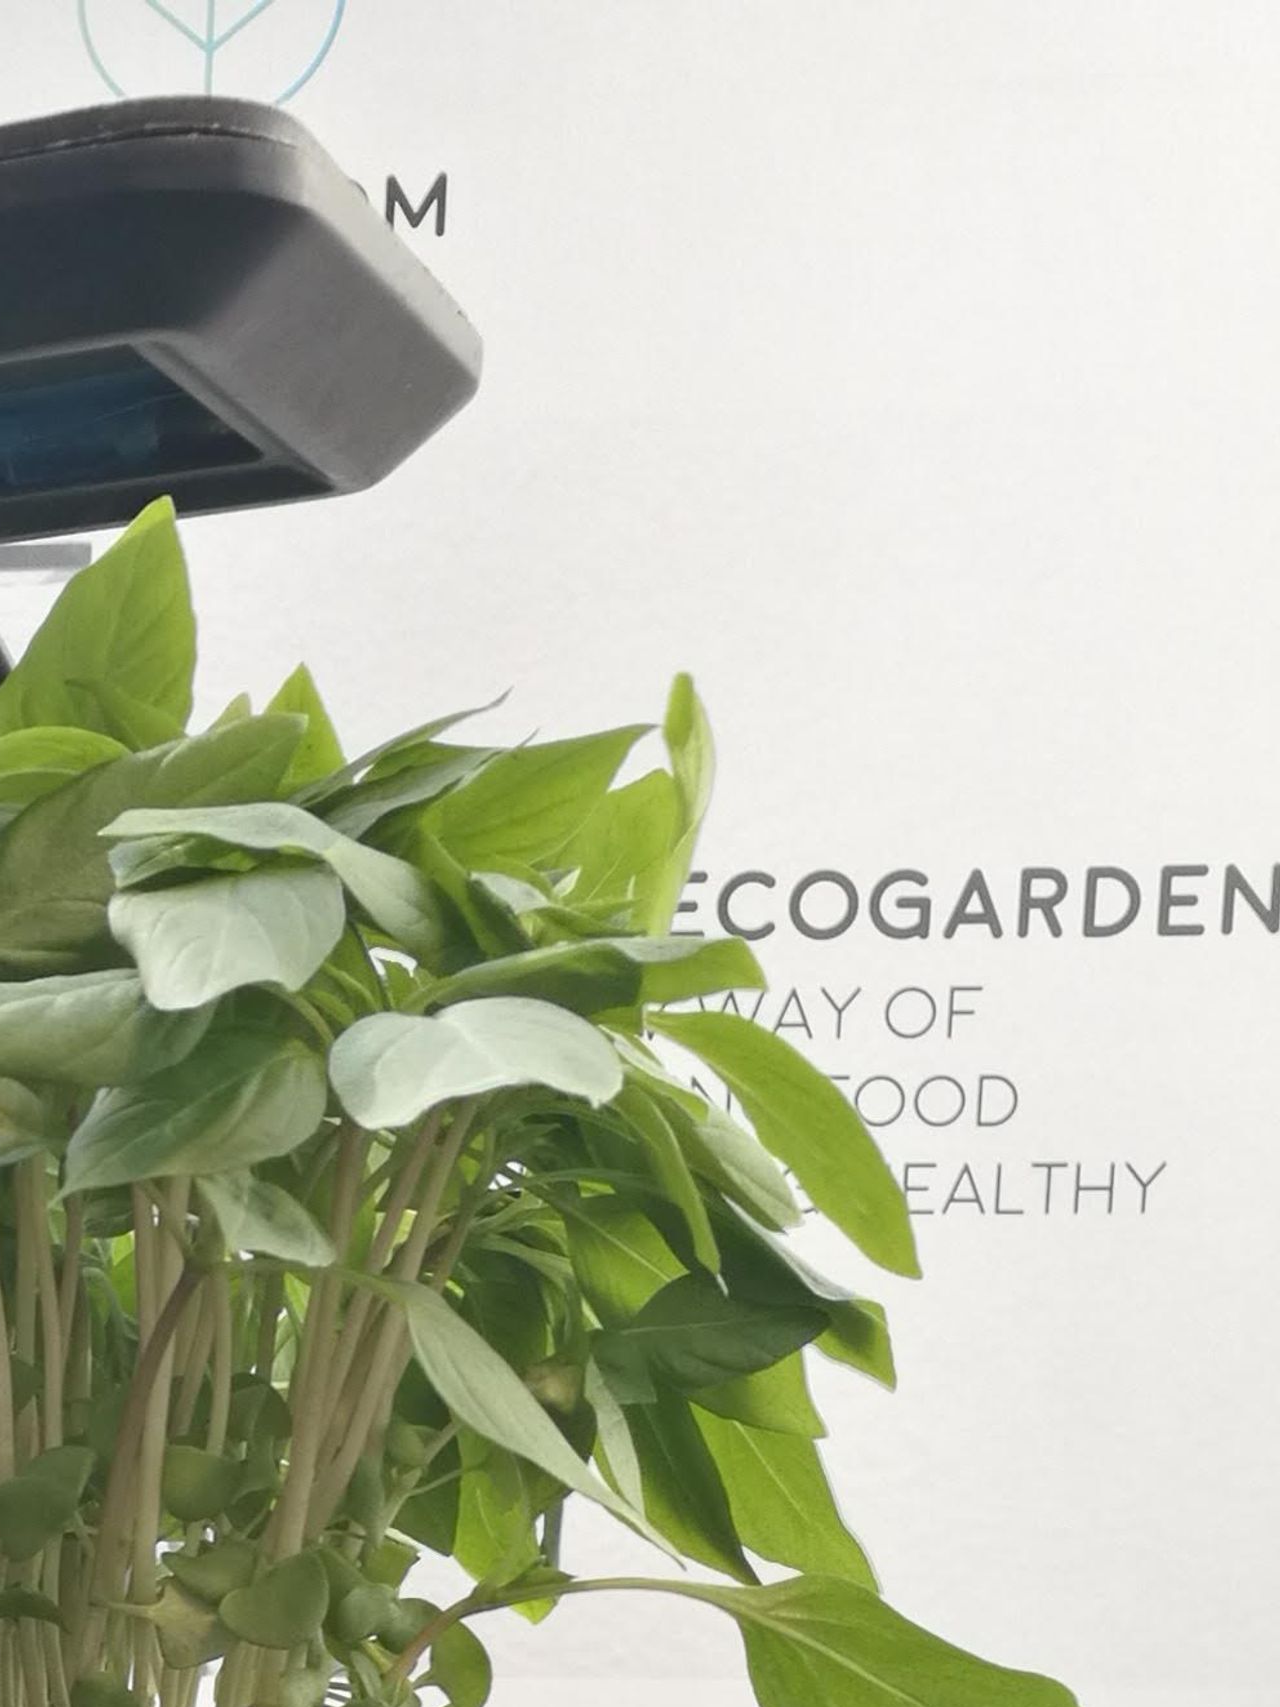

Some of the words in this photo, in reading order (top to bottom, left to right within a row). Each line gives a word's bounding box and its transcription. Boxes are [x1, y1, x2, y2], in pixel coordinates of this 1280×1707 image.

[670, 862, 1280, 940] ECOGARDEN
[885, 985, 984, 1039] OF
[830, 1075, 1019, 1128] OOD
[902, 1160, 1168, 1217] EALTHY
